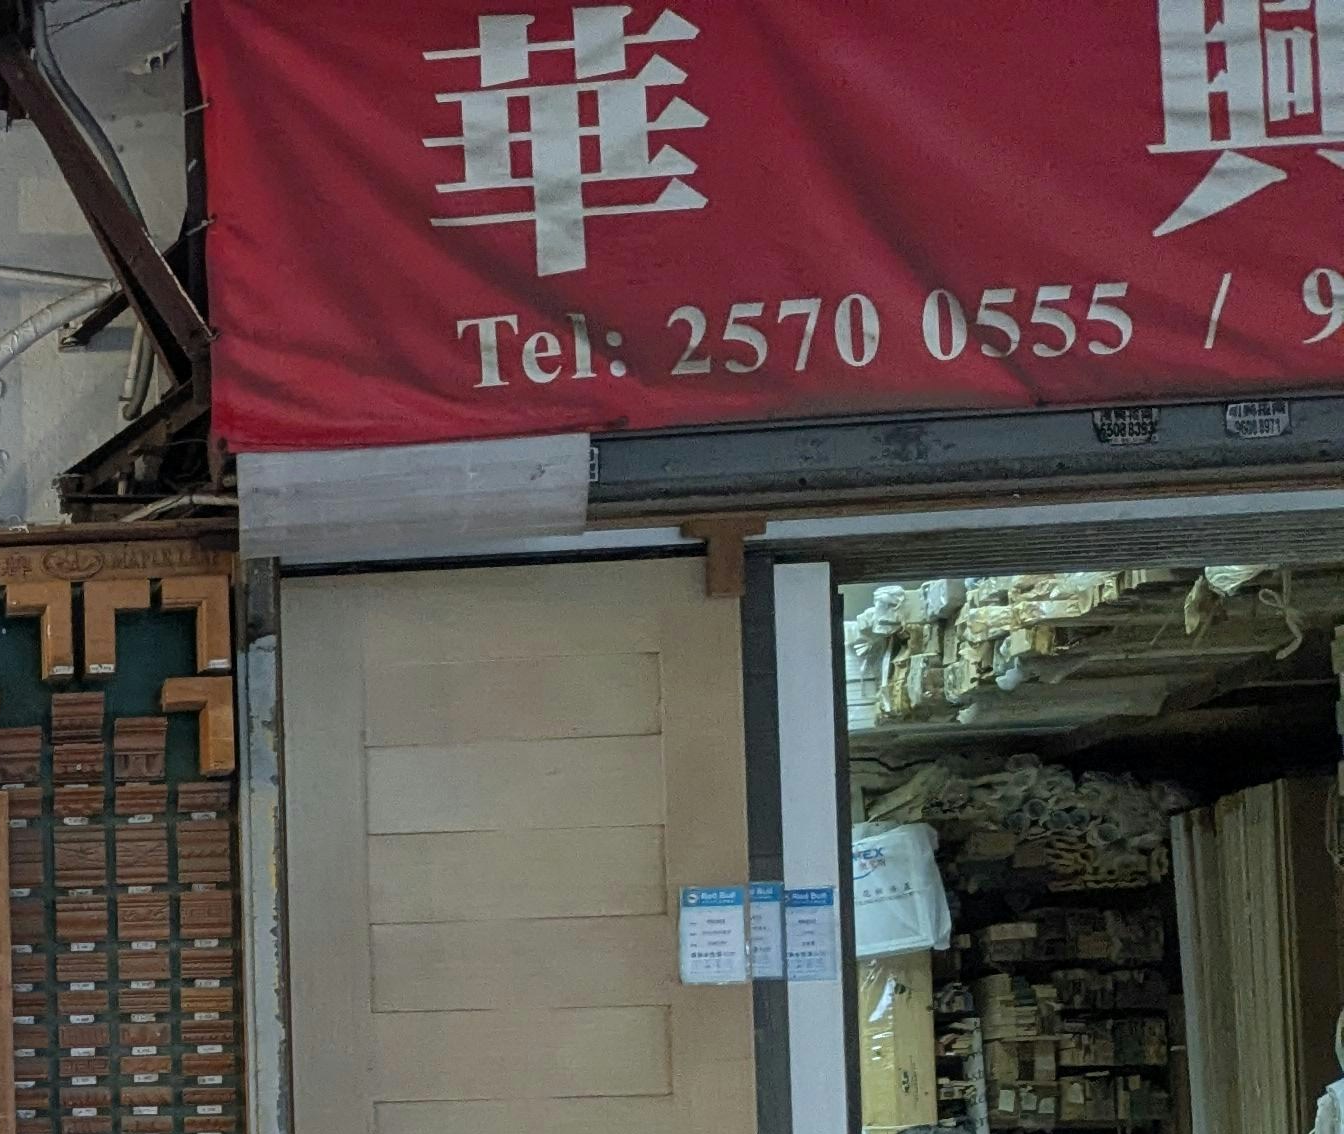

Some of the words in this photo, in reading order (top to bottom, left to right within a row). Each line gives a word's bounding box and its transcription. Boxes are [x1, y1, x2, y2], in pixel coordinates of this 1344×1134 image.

[423, 7, 709, 277] 華
[456, 313, 627, 388] Tel:
[666, 293, 879, 376] 2570
[922, 282, 1133, 362] 0555
